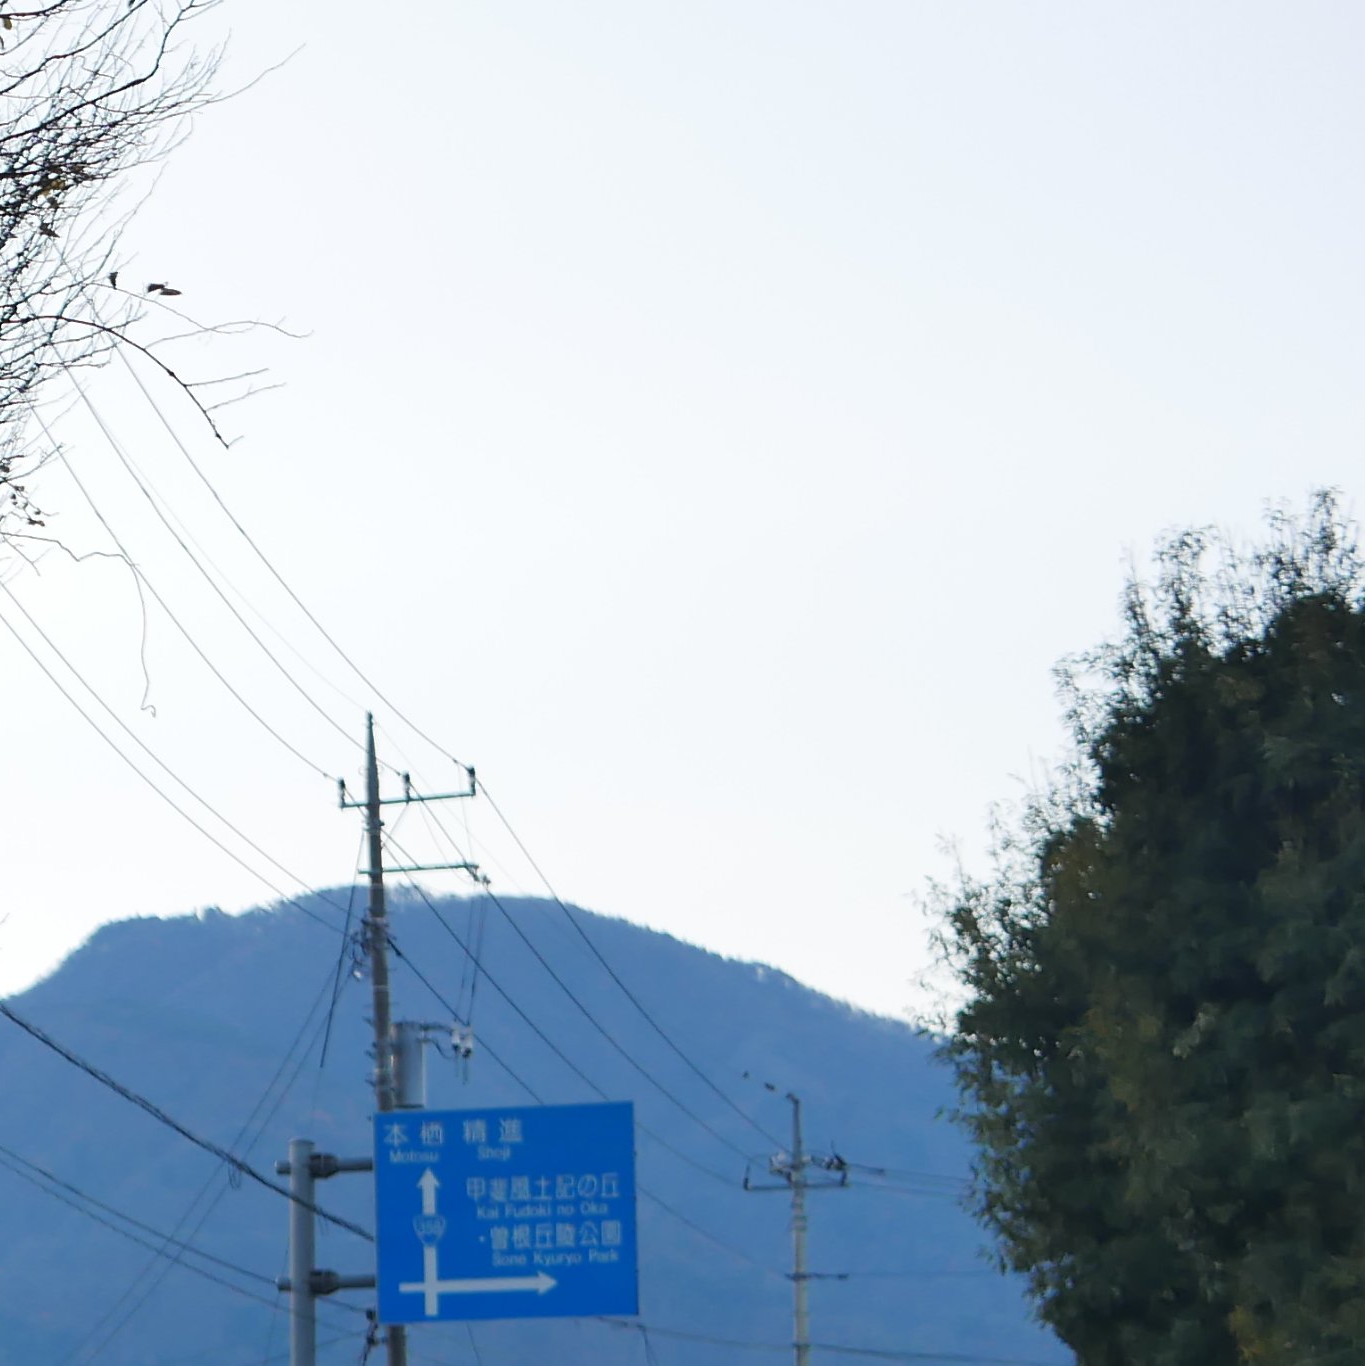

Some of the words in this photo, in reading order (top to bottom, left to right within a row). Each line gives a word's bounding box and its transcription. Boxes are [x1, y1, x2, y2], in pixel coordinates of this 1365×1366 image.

[389, 1149, 439, 1164] Motosu
[477, 1145, 511, 1161] Shoji
[476, 1204, 499, 1219] Kai
[505, 1202, 551, 1218] Fudoki
[557, 1204, 575, 1216] no
[580, 1200, 608, 1215] Oka
[492, 1250, 527, 1266] Sone
[533, 1250, 582, 1266] Kyuryo
[588, 1247, 618, 1263] Park
